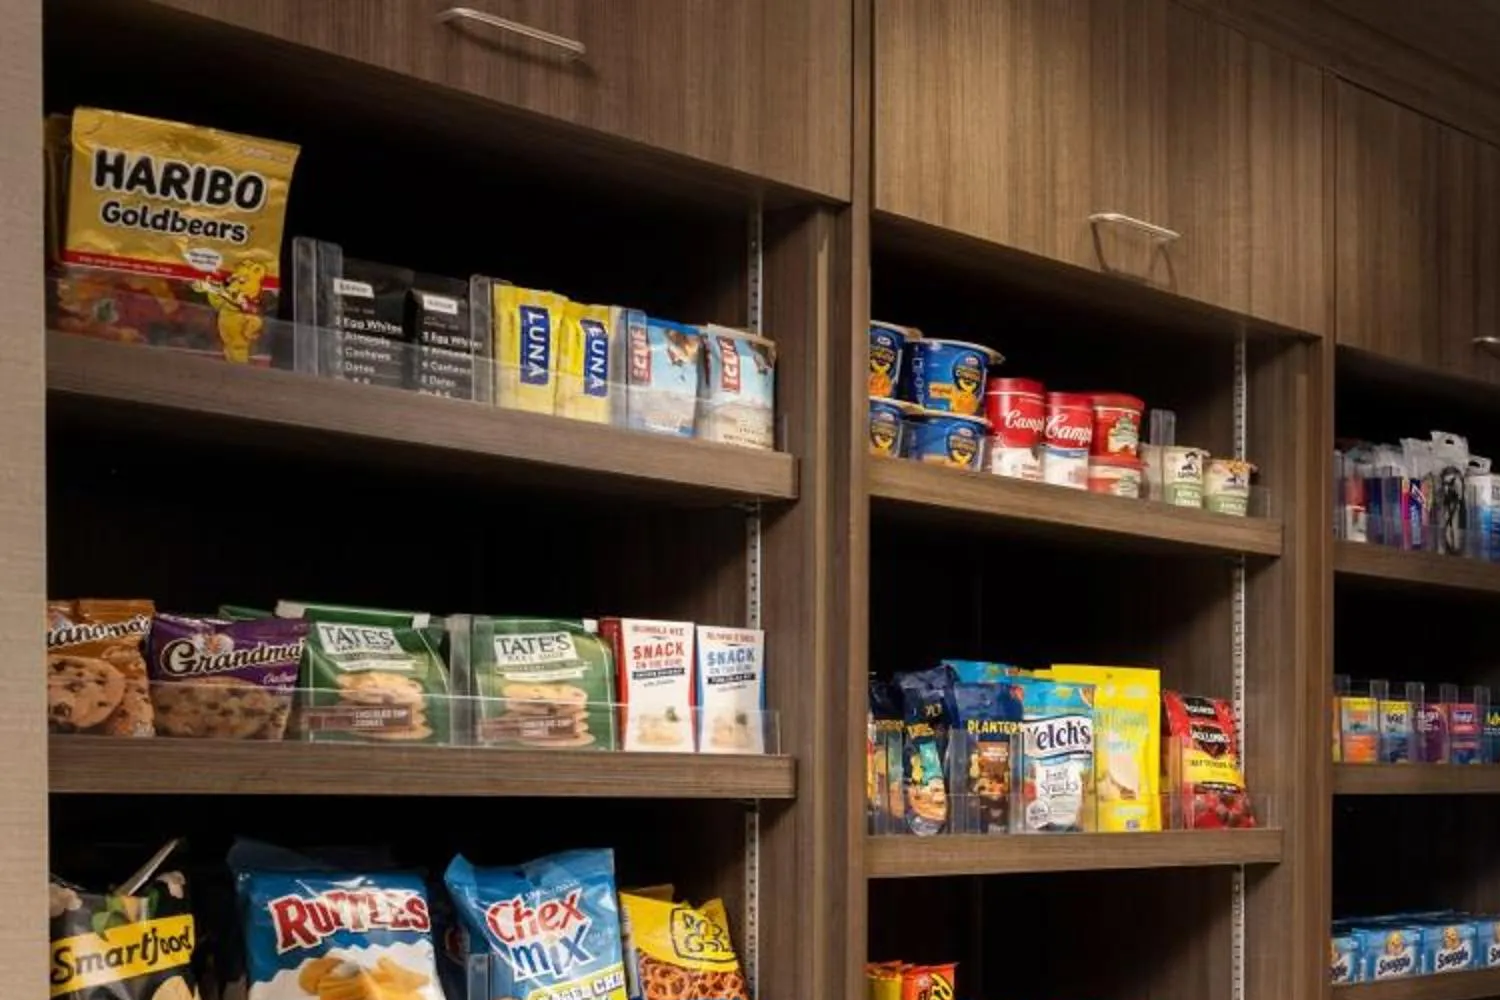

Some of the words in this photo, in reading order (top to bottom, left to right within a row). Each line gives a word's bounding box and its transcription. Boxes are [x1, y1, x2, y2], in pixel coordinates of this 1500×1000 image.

[93, 148, 265, 210] HARIBO
[101, 201, 247, 243] Goldbears
[527, 310, 546, 379] LUNA
[587, 326, 608, 390] LUNA
[496, 634, 571, 655] TATE'S
[633, 640, 685, 660] SNACK
[707, 647, 756, 667] SNACK
[486, 886, 586, 946] Chex
[51, 923, 195, 985] Smartfood
[1378, 956, 1412, 976] Snuggle
